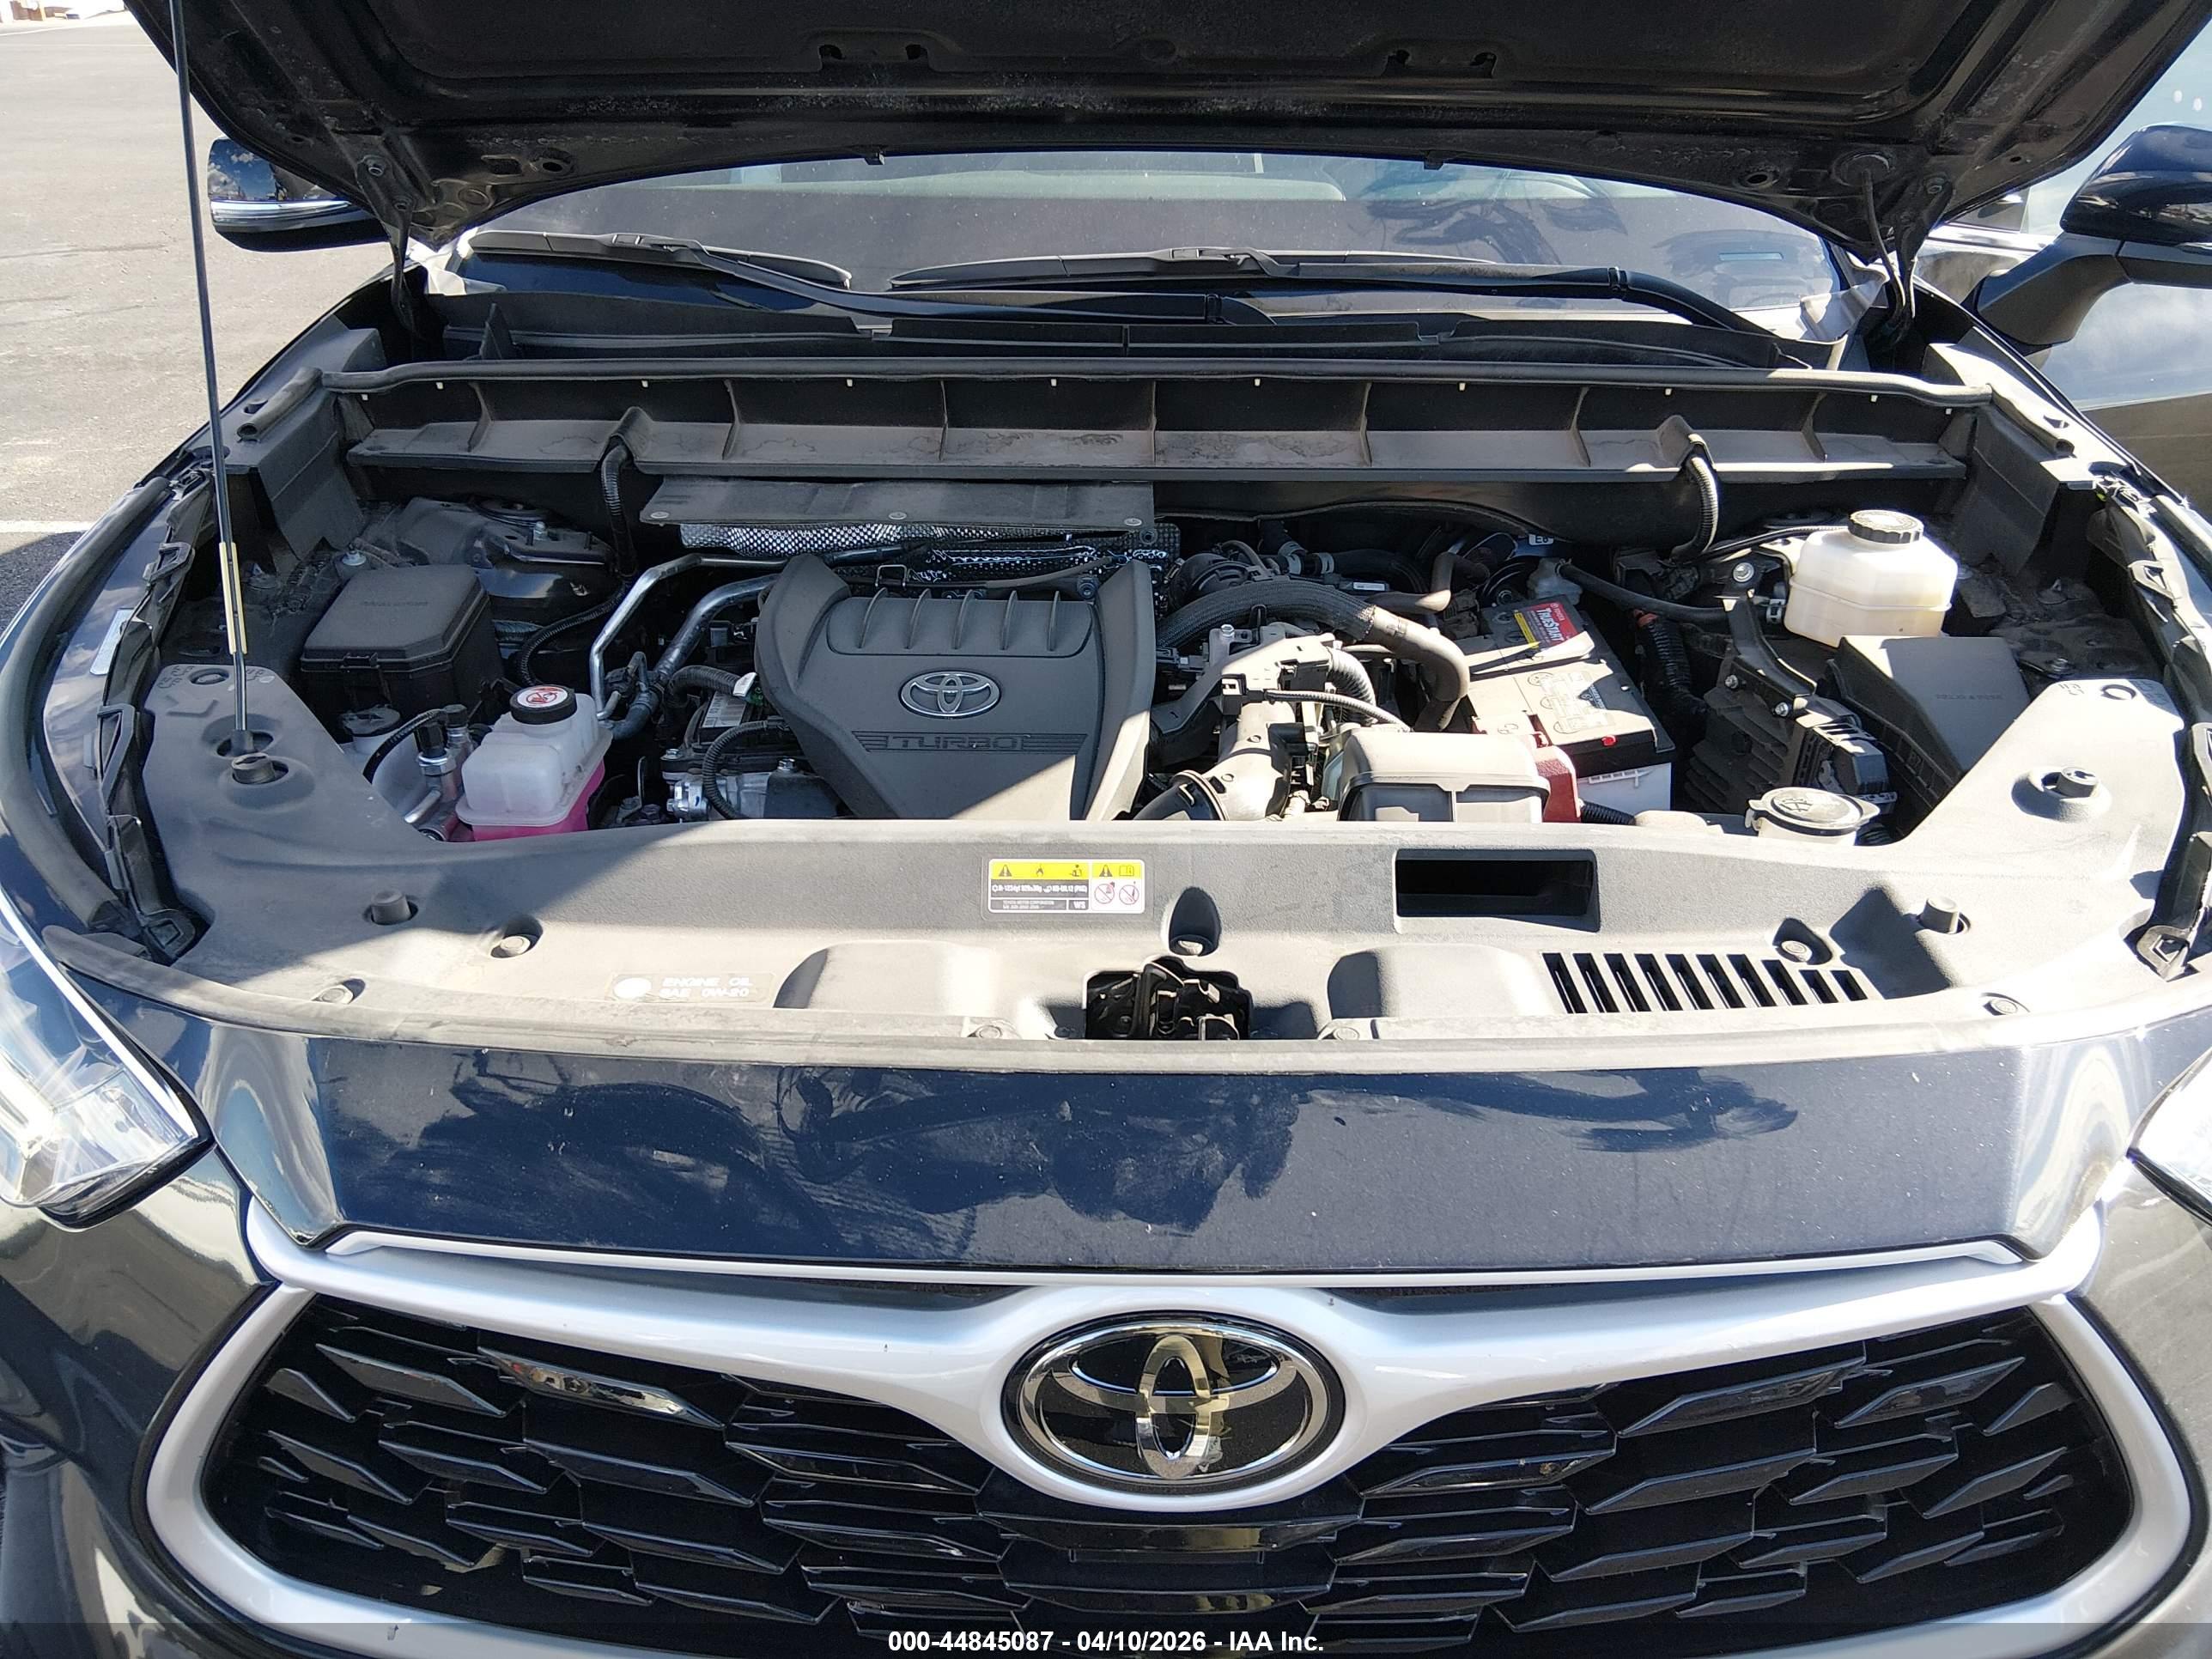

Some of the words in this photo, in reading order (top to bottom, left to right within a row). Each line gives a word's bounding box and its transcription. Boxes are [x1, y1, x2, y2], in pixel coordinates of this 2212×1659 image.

[890, 736, 1018, 750] TURBO
[662, 976, 721, 988] ENGINE
[727, 976, 754, 988] OIL
[659, 988, 692, 998] SAE
